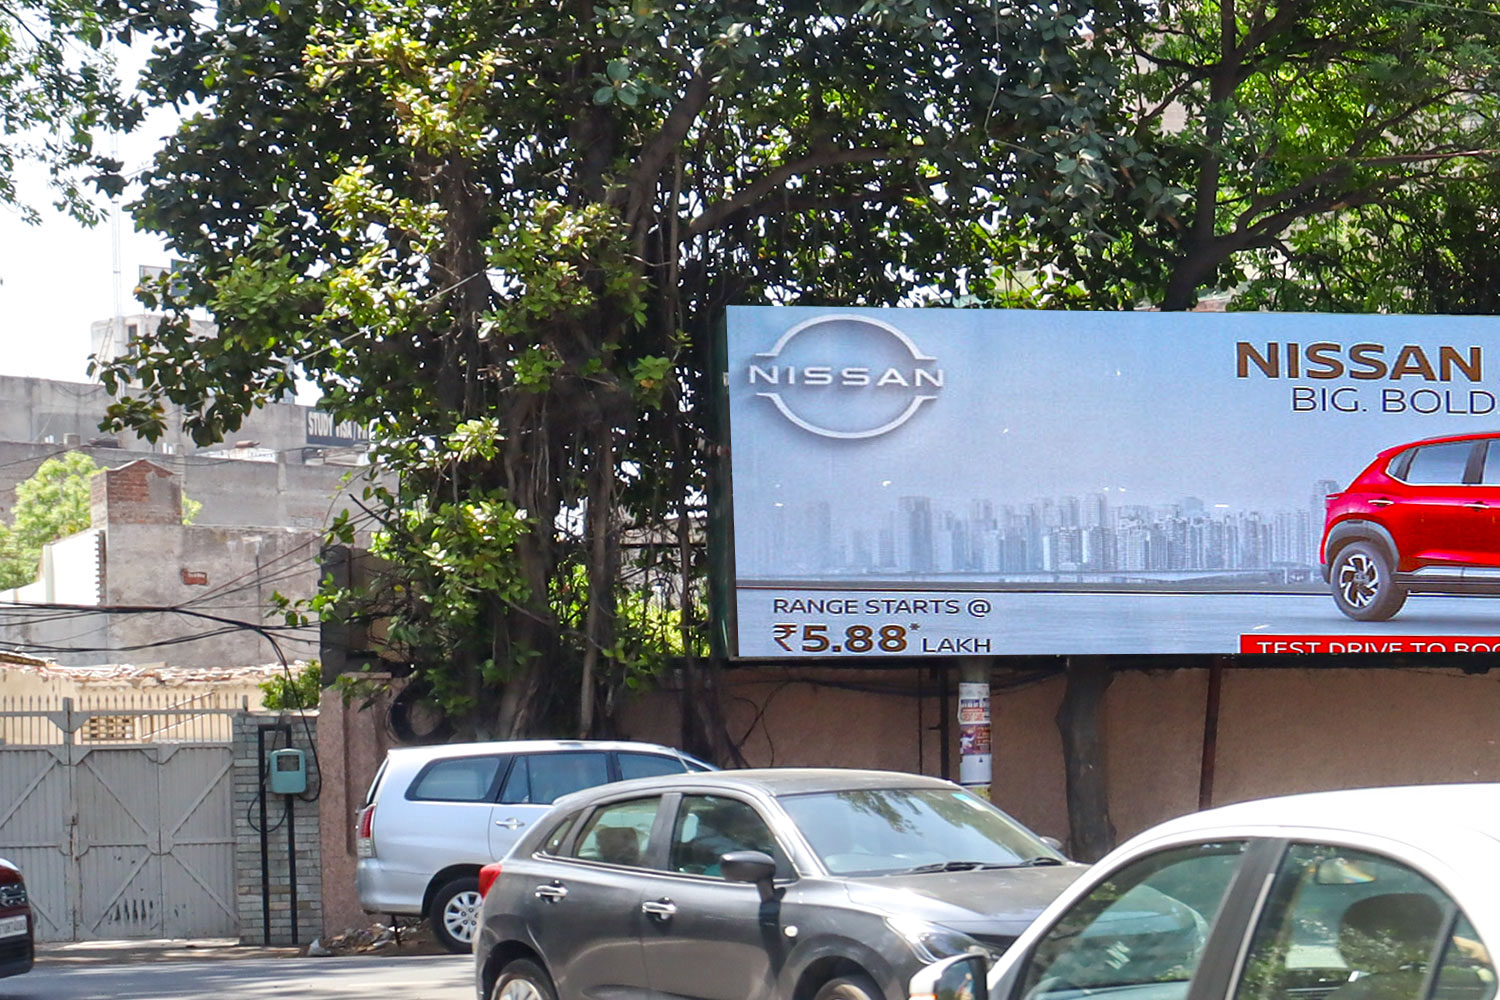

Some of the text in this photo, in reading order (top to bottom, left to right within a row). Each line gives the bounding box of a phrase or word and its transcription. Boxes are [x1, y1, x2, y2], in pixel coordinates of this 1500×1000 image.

[1236, 341, 1482, 383] NISSAN
[749, 364, 945, 387] NISSAN
[1292, 386, 1368, 413] BIG.
[308, 411, 334, 437] STUDY
[773, 598, 992, 617] RANGE STARTS @
[922, 637, 992, 653] LAKH
